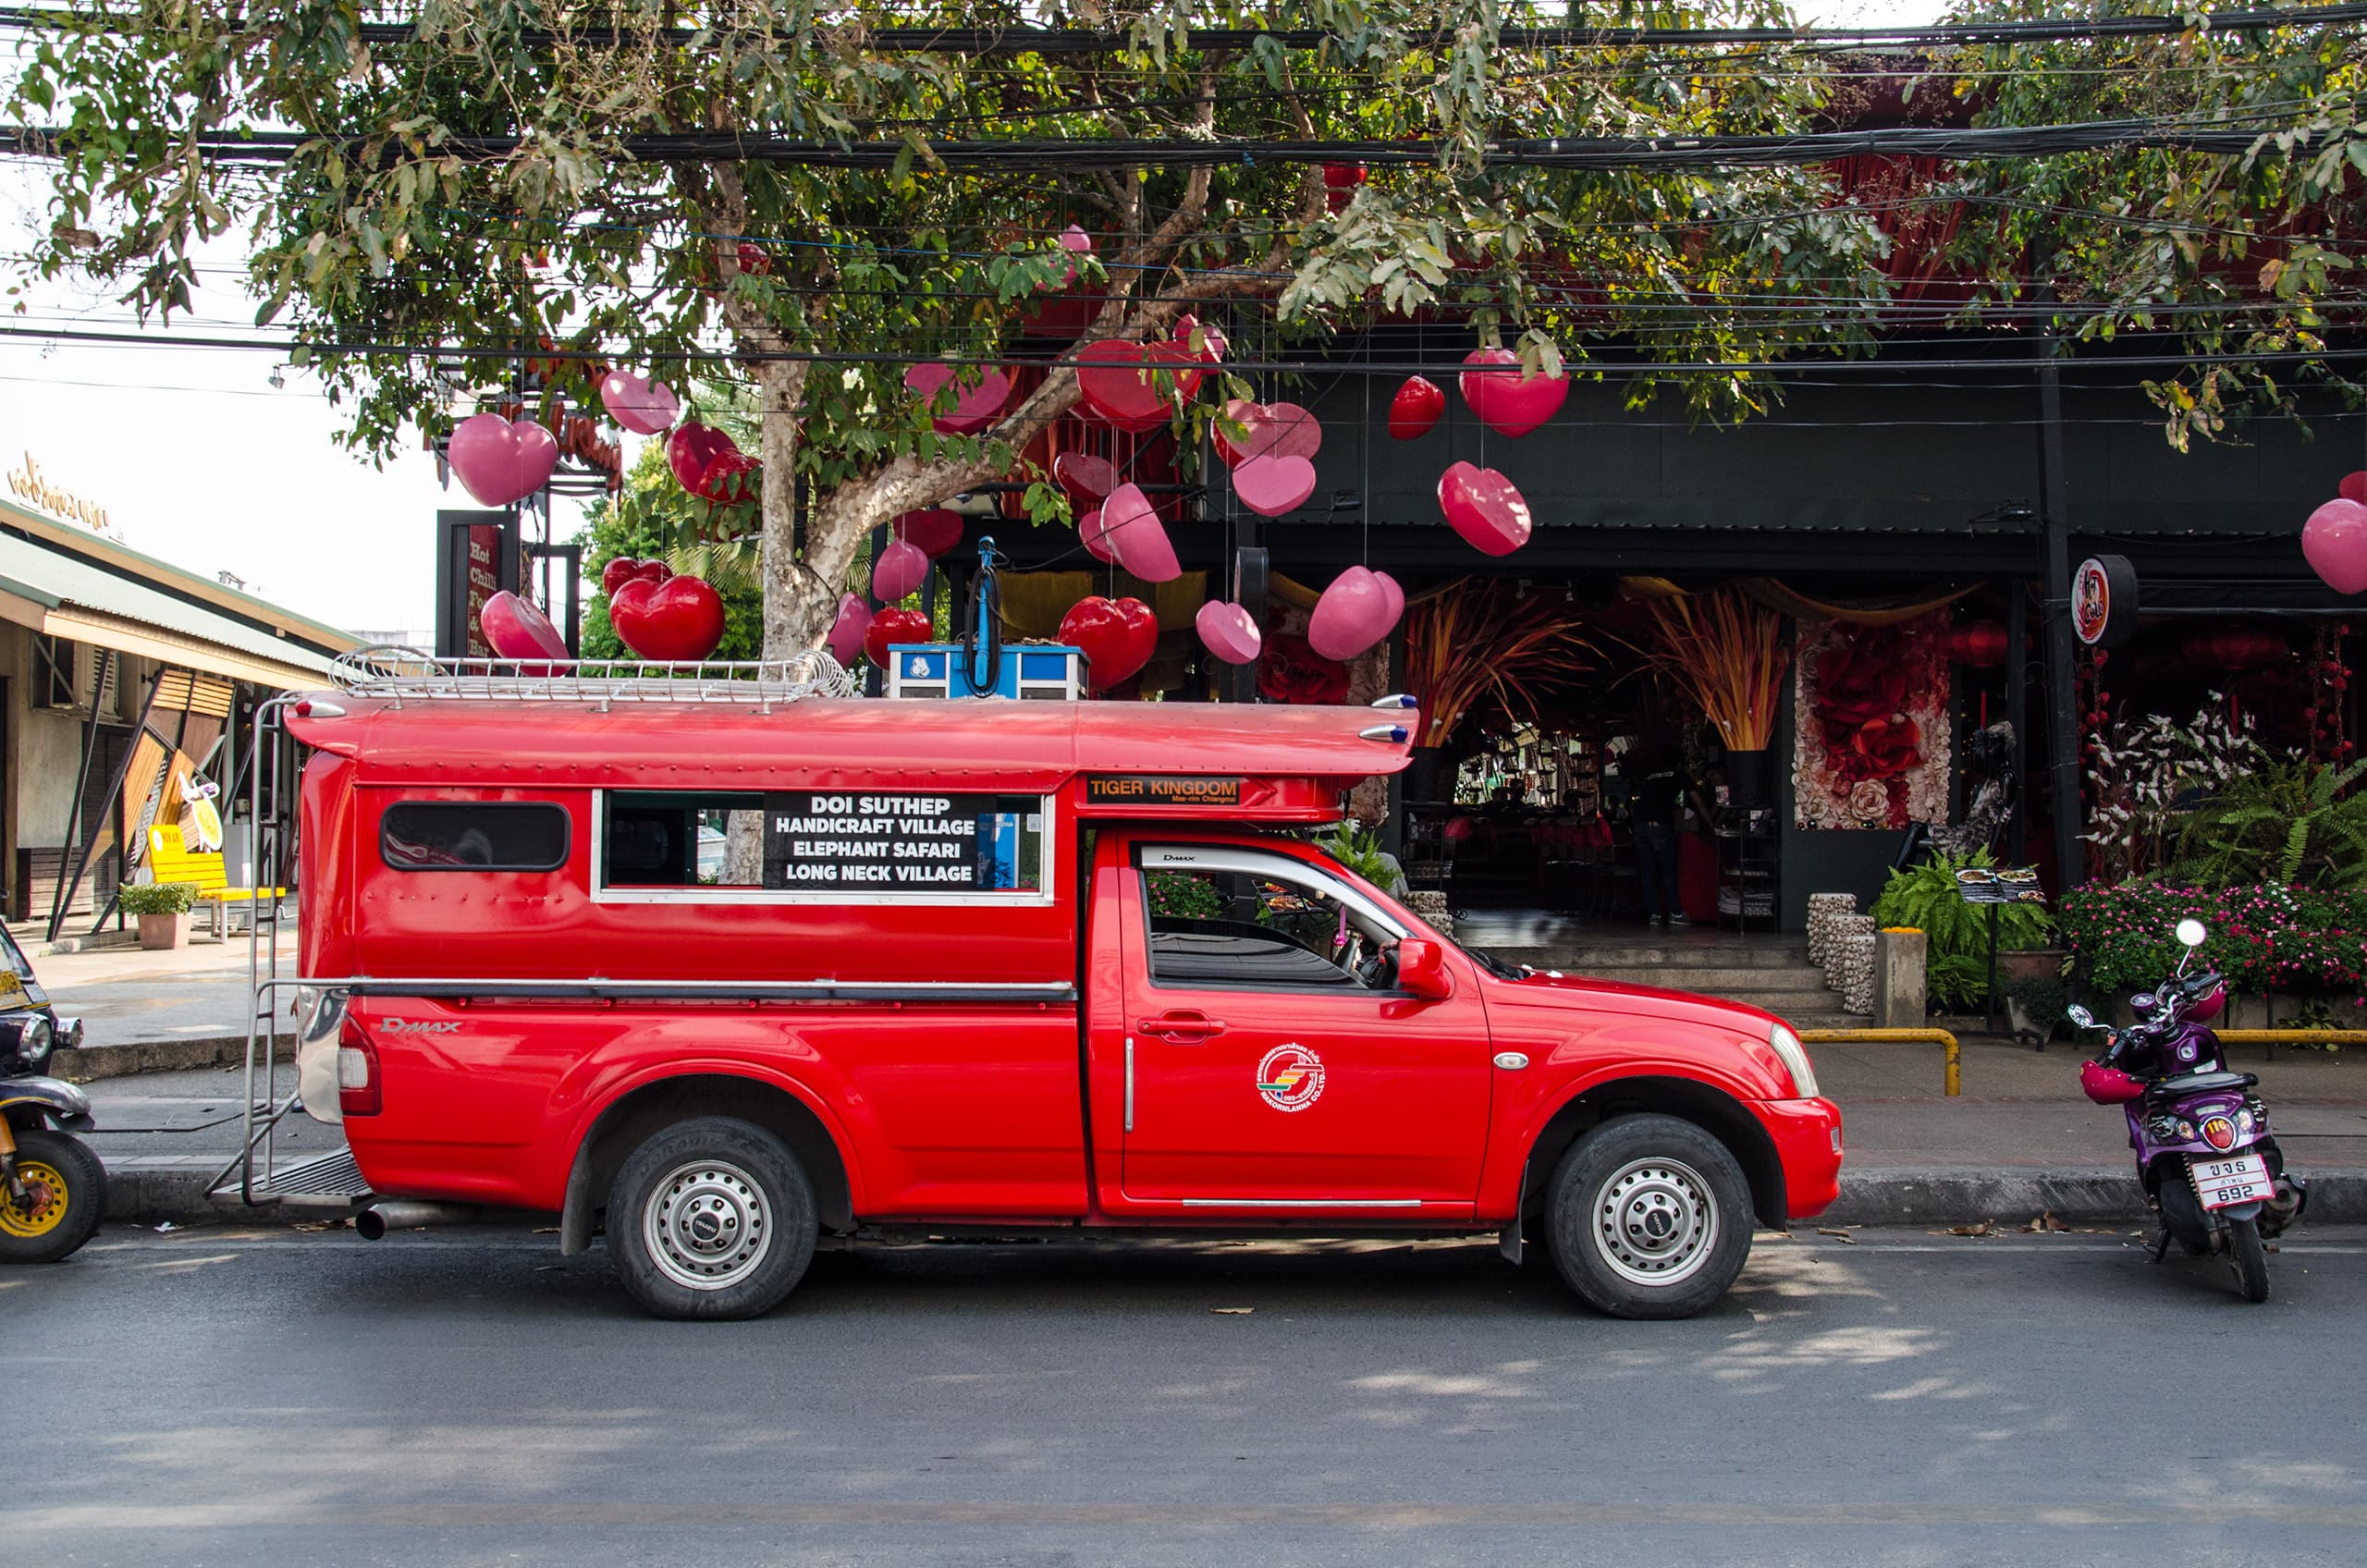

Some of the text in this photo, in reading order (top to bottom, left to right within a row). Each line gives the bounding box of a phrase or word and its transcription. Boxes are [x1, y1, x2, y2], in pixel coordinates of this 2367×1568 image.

[470, 541, 490, 565] Hot
[470, 619, 479, 632] &
[469, 638, 490, 658] Bar
[1090, 779, 1237, 796] TIGER KINGDOM
[811, 796, 950, 815] DOI SUTHEP
[1202, 795, 1236, 803] Chiangmai
[776, 817, 975, 836] HANDICRAFT VILLAGE
[793, 840, 961, 858] ELEPHANT SAFARI
[787, 864, 837, 881] LONG
[841, 864, 891, 881] NECK
[895, 865, 973, 882] VILLAGE
[1260, 1091, 1312, 1113] NAKORNLANNA
[2206, 1120, 2226, 1134] 116
[2217, 1185, 2254, 1202] 692
